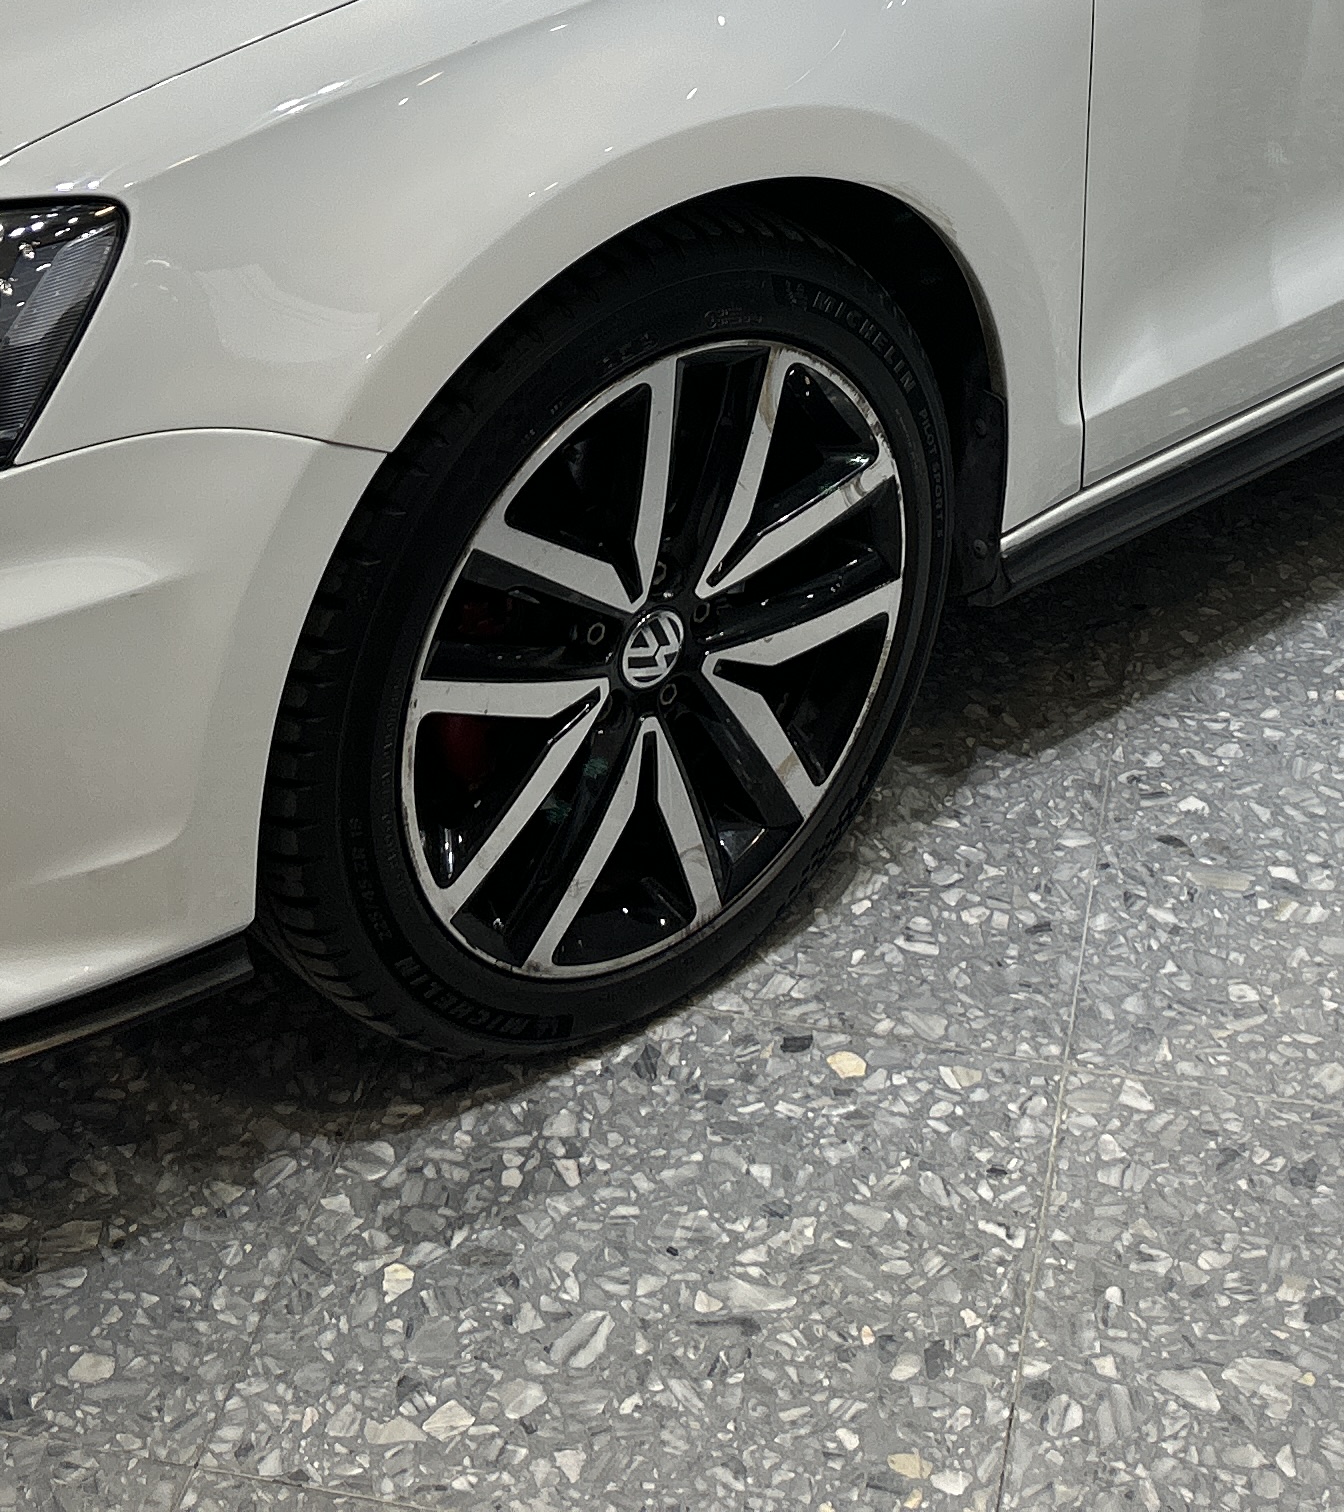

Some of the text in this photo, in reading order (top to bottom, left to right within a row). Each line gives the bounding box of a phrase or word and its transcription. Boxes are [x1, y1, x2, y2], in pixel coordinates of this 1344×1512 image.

[813, 290, 916, 396] MICHELIN
[917, 407, 938, 455] PILOT
[931, 460, 945, 522] SPORT
[393, 955, 531, 1036] MICHELIN
